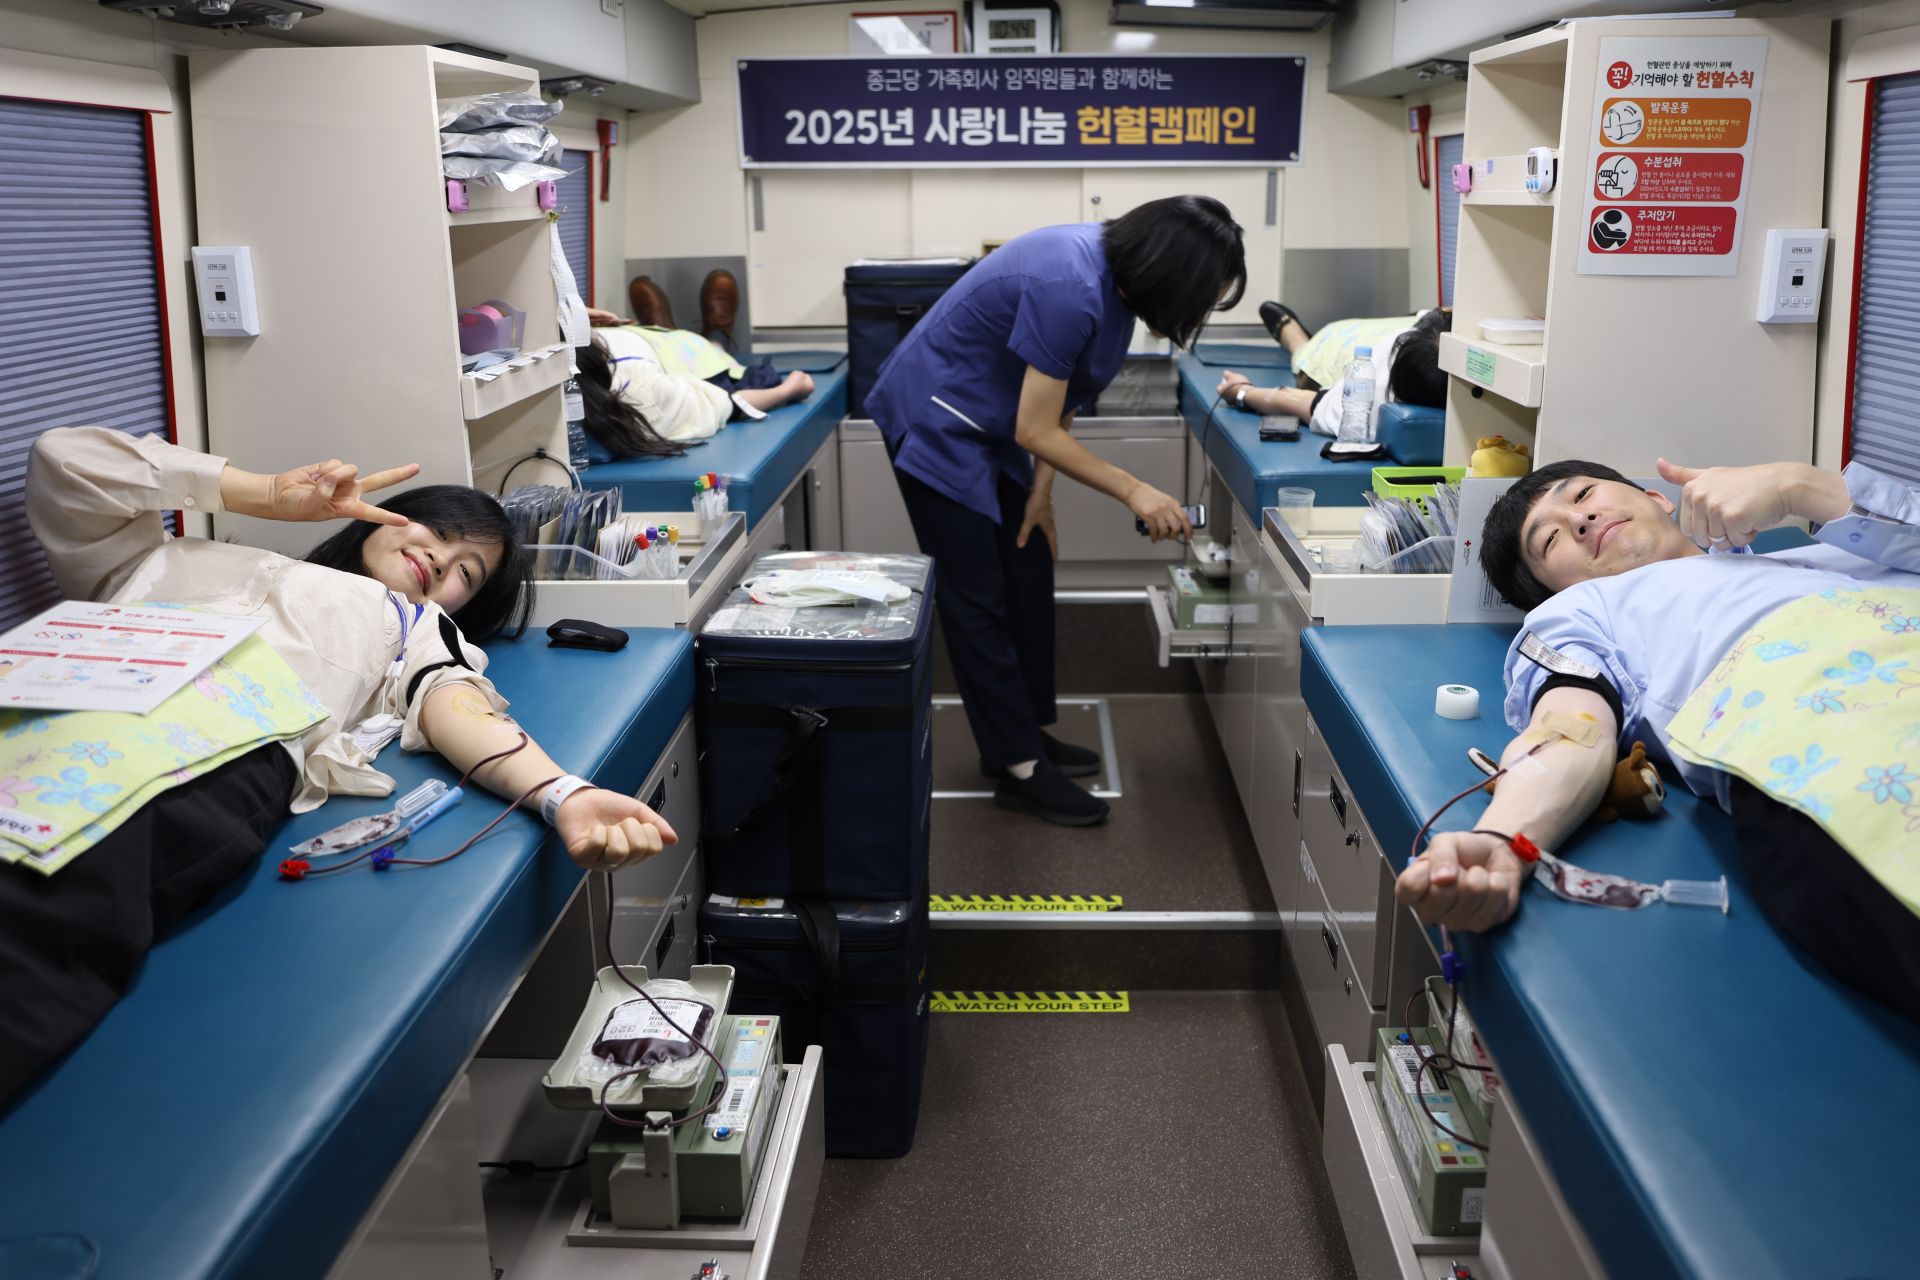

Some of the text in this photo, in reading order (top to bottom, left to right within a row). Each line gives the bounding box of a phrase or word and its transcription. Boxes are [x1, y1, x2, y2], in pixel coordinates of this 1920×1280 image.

[1720, 61, 1732, 70] 위해
[867, 68, 1174, 91] 종근당 가족회사 임직원들과 함께하는
[1611, 67, 1754, 89] 꼭! 기억해야 할 헌혈수칙
[1651, 102, 1689, 114] 발목운동
[785, 107, 1256, 146] 2025년 사랑나눔 헌혈캠페인
[1644, 156, 1682, 168] 수분섭취
[1637, 210, 1675, 222] 주저앉기
[955, 1002, 1124, 1010] WATCH YOUR STEP
